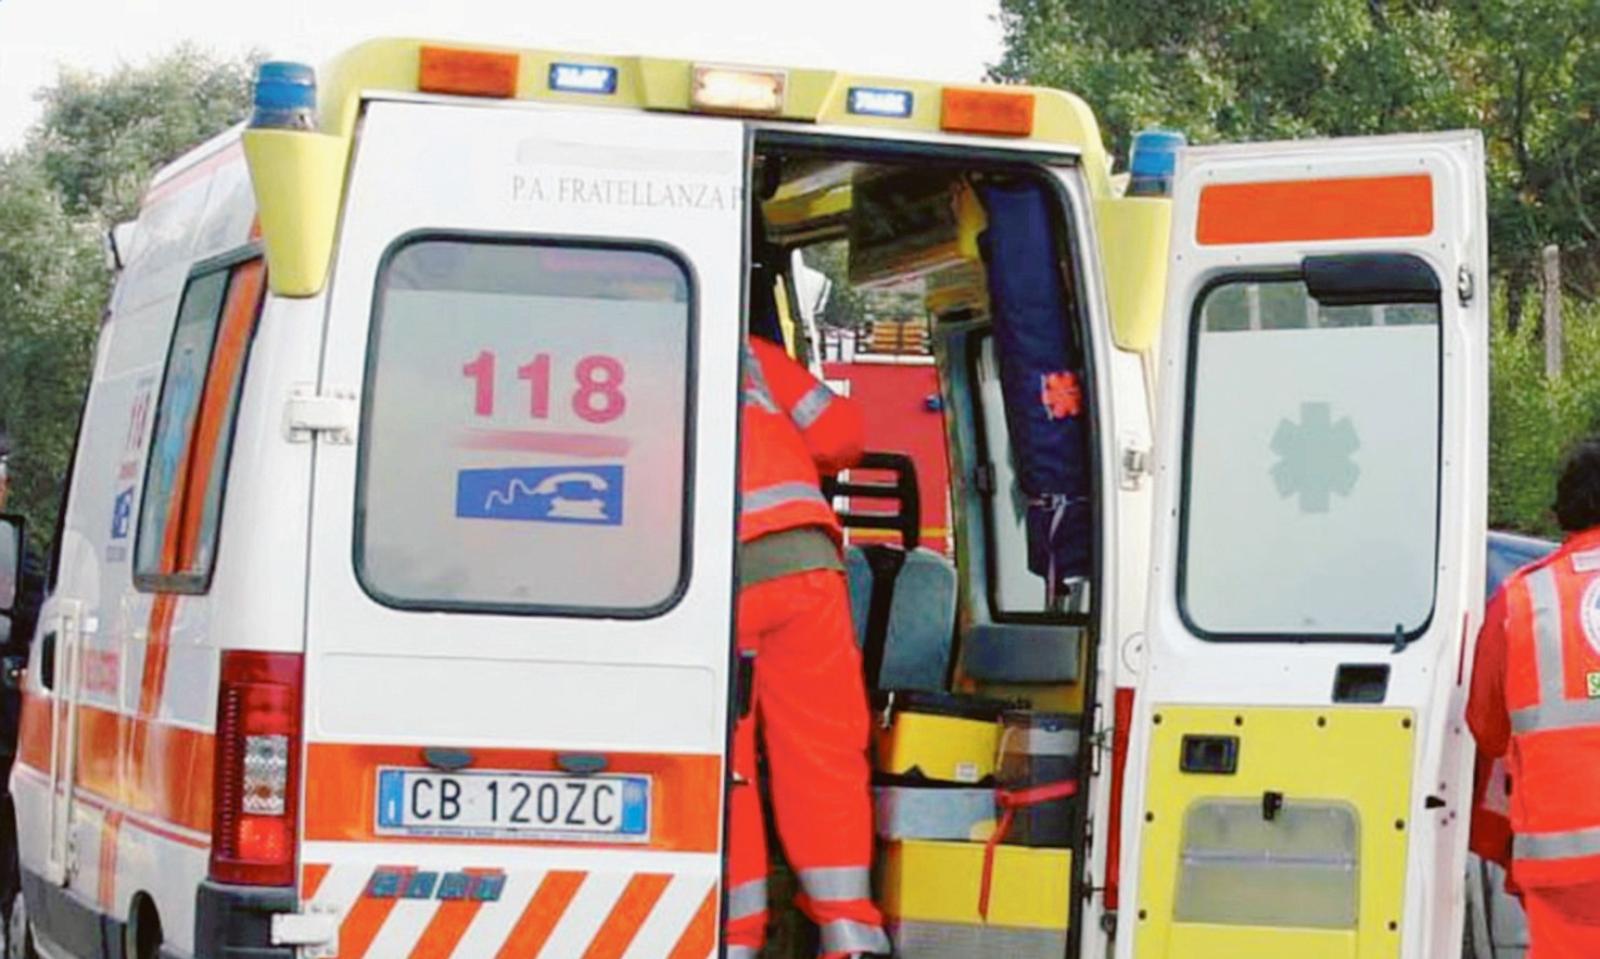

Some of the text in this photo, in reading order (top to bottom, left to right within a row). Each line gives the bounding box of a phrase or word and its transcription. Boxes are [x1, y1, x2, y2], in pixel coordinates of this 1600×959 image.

[557, 176, 725, 210] FRATELLANZA
[463, 350, 627, 425] 118
[411, 778, 615, 826] CB 120ZC
